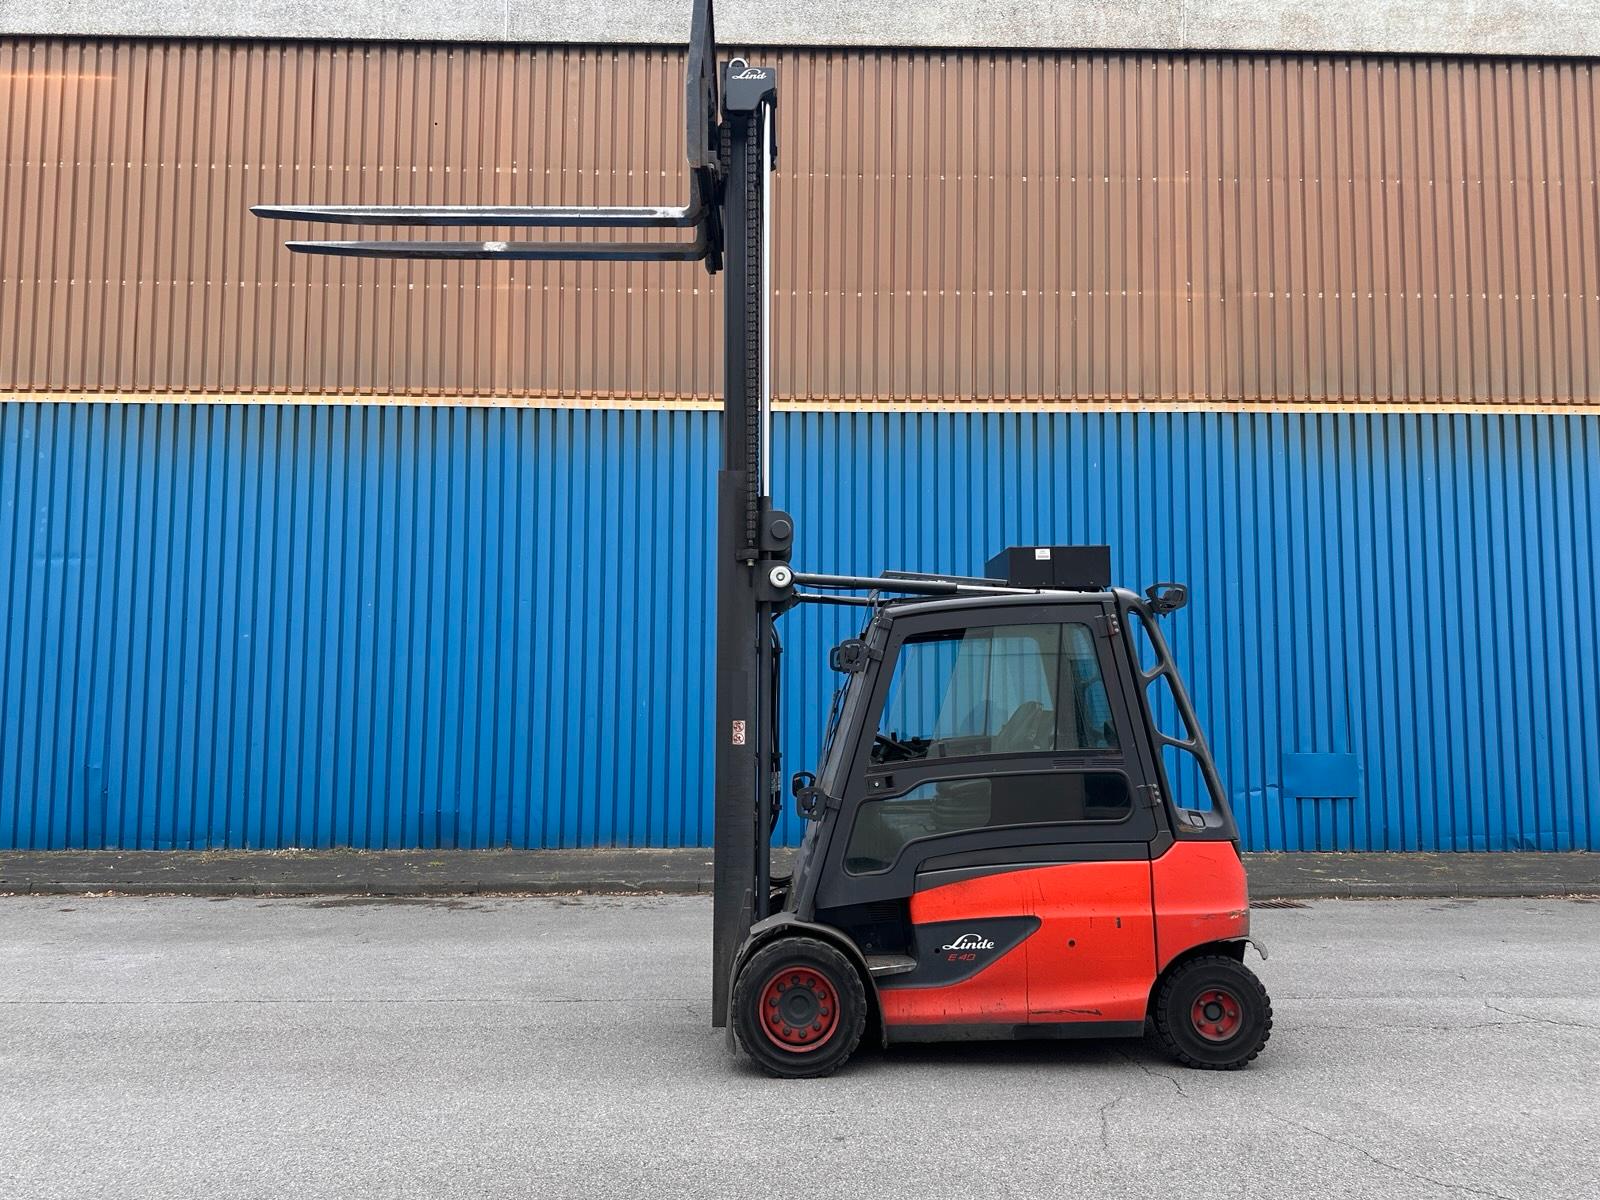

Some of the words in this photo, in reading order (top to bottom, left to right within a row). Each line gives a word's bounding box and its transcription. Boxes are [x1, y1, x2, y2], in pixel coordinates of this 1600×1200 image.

[942, 933, 995, 950] Linde
[947, 953, 957, 961] E
[959, 953, 976, 961] 40
